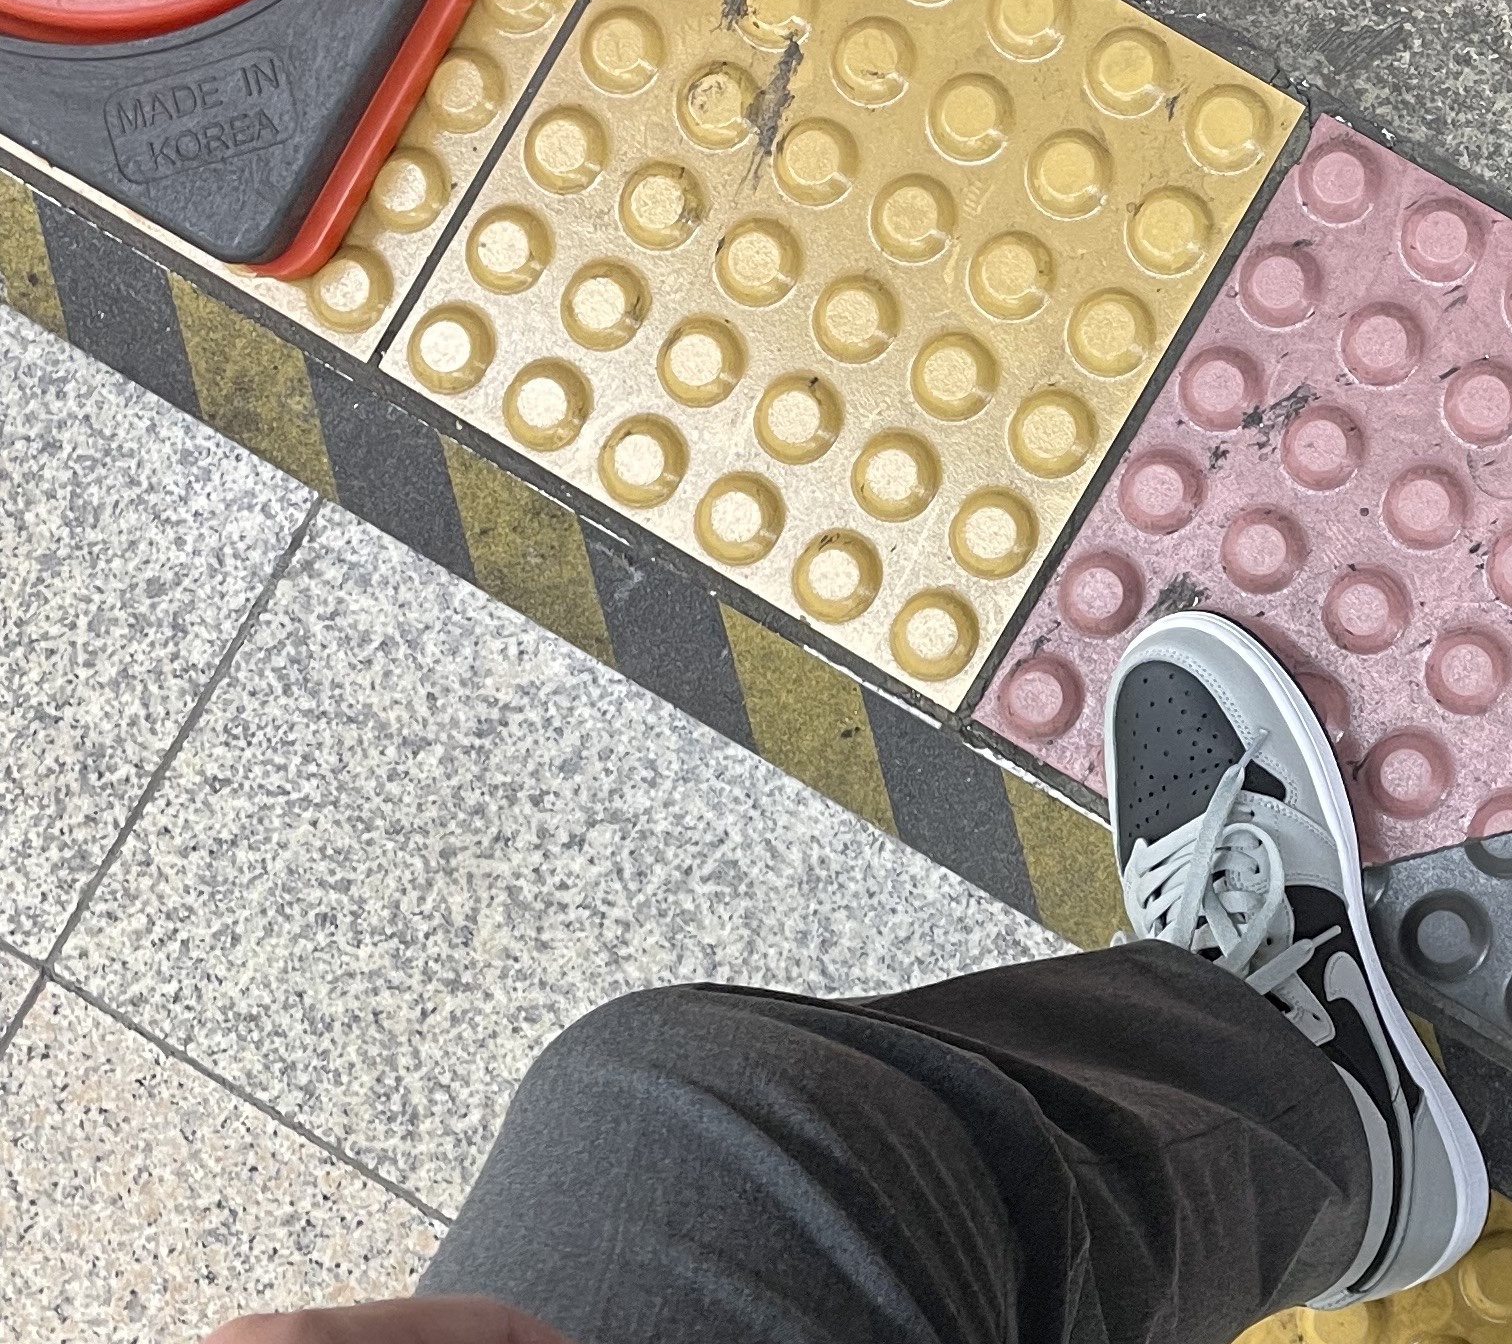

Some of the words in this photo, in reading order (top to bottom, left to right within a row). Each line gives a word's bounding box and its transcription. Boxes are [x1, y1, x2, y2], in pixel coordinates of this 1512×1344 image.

[116, 75, 224, 135] MADE
[240, 58, 280, 97] IN
[149, 108, 280, 171] KOREA
